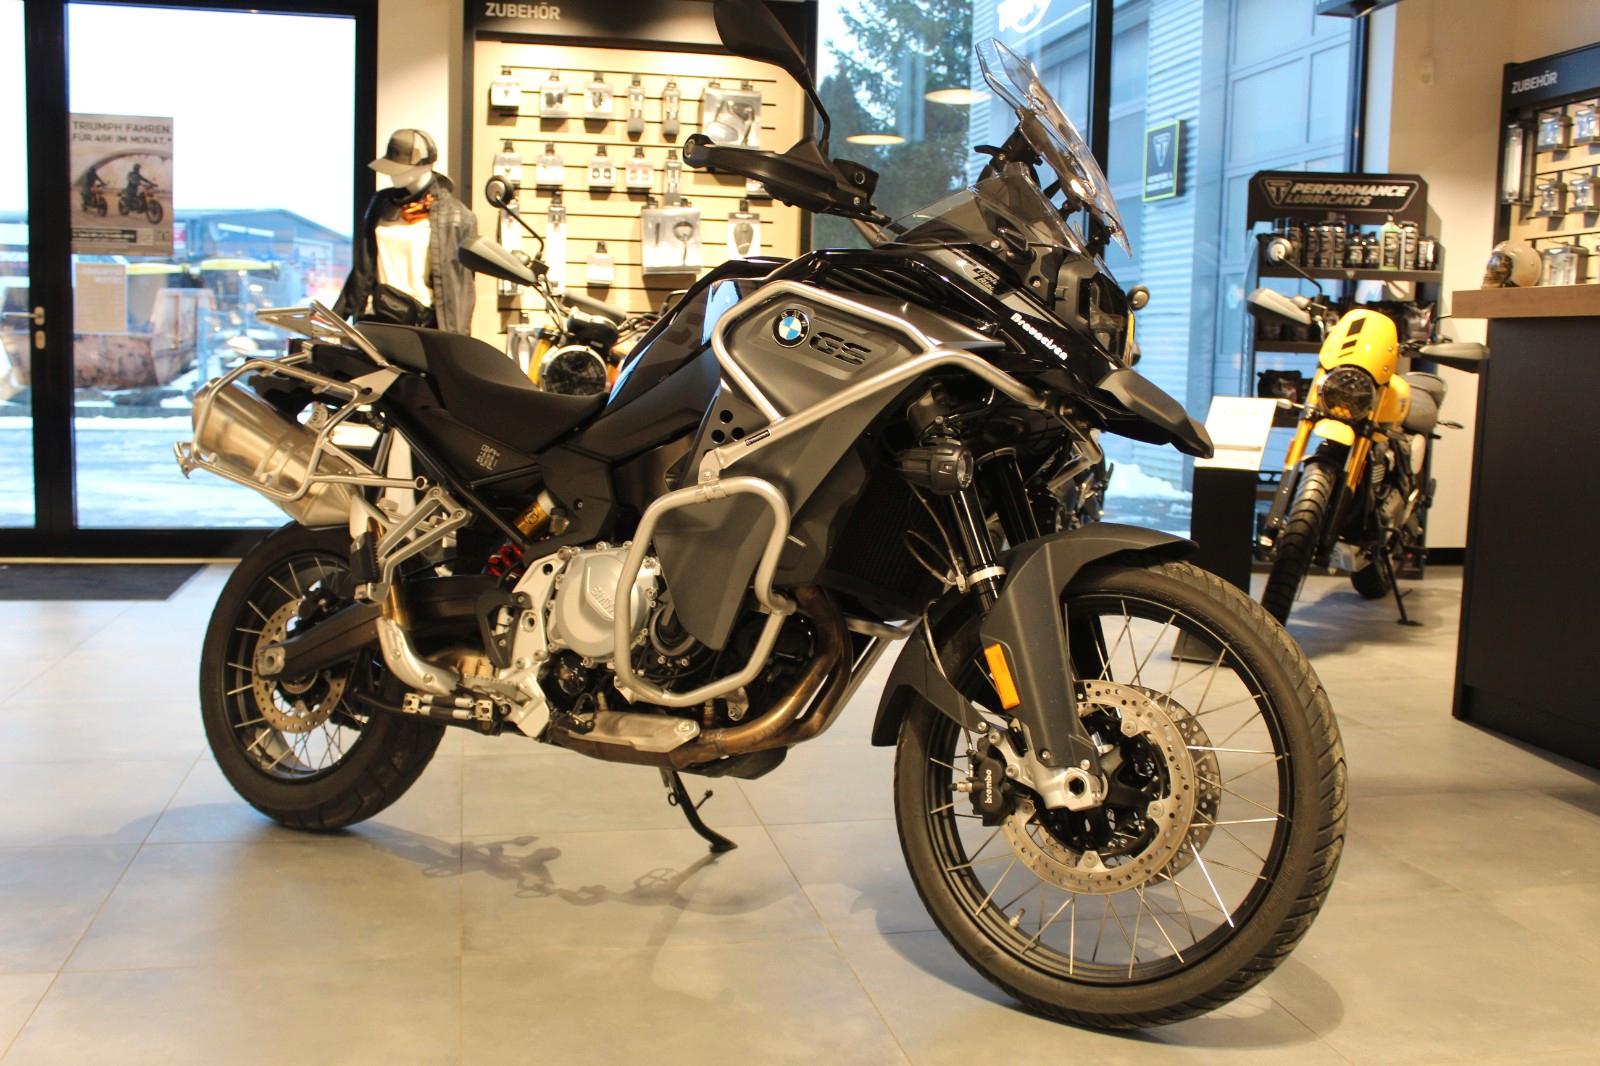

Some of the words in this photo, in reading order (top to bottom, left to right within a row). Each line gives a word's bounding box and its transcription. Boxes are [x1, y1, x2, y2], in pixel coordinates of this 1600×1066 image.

[485, 2, 560, 20] ZUBEHÖR
[1511, 70, 1558, 94] ZUBEHÖR
[72, 120, 122, 132] TRIUMPH
[1291, 183, 1410, 197] PERFORMANCE
[1285, 194, 1373, 206] LUBRICANTS
[809, 332, 873, 366] GS
[984, 769, 993, 804] brembo
